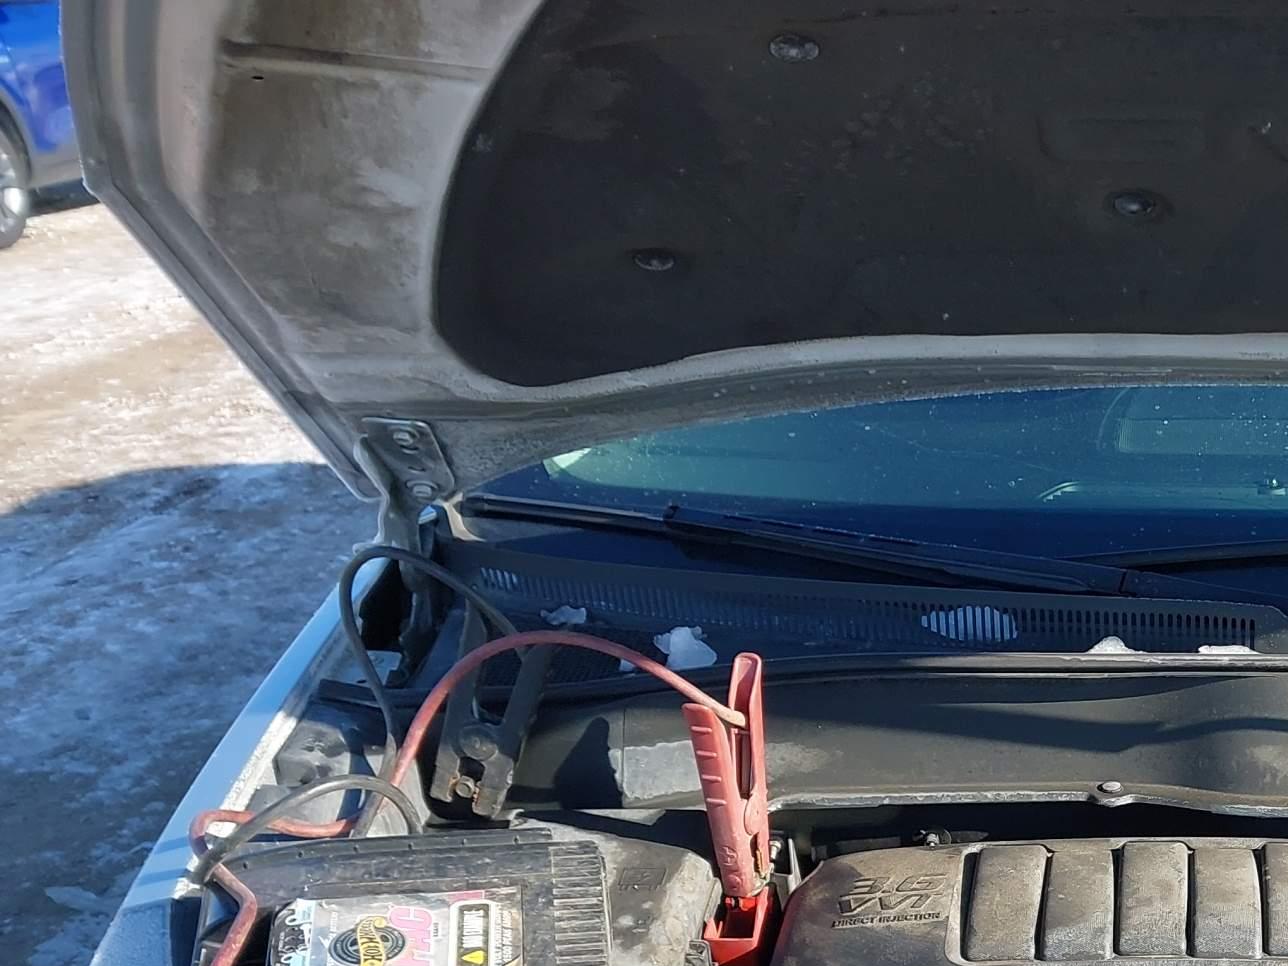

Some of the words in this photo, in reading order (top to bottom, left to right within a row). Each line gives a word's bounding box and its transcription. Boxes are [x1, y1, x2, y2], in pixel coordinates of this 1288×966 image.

[831, 917, 878, 928] DIRECT
[878, 912, 941, 924] INJECTION
[362, 946, 383, 962] HOT
